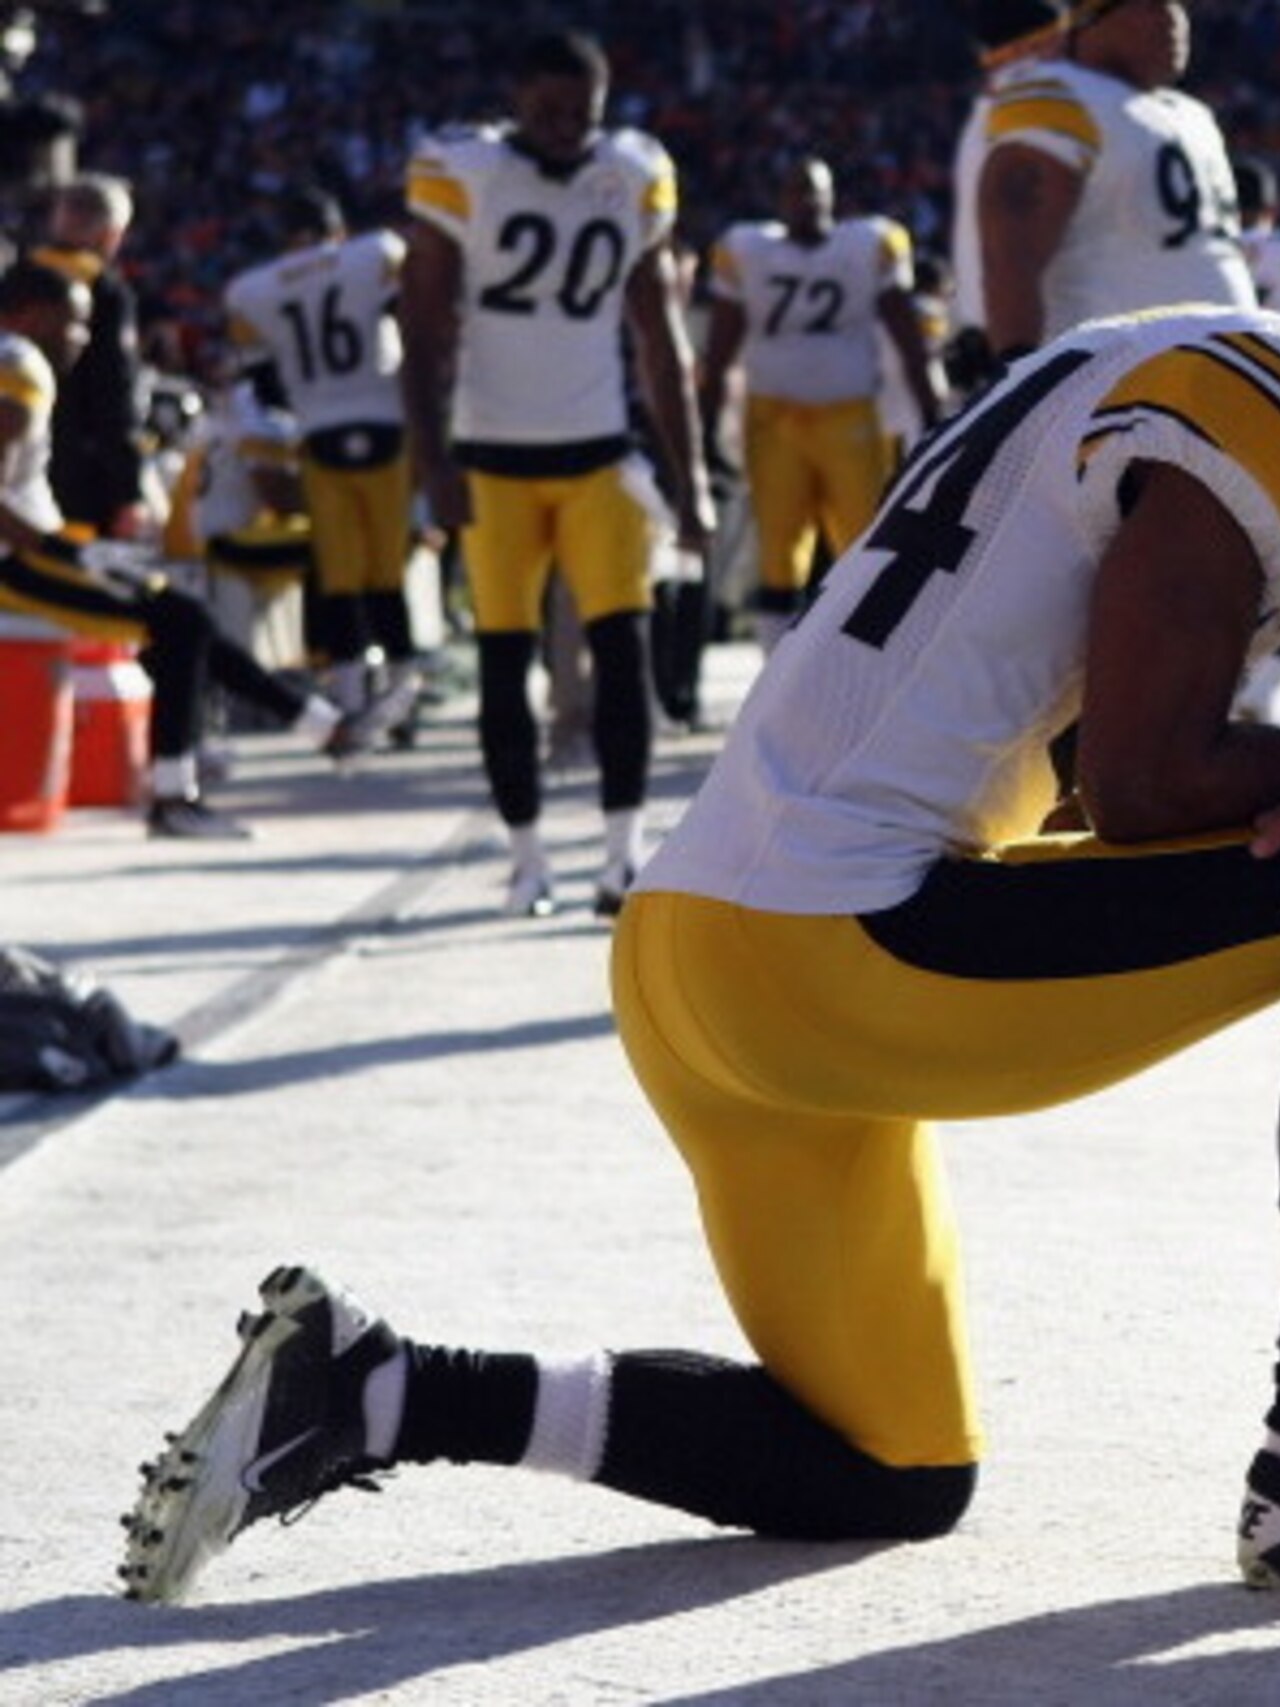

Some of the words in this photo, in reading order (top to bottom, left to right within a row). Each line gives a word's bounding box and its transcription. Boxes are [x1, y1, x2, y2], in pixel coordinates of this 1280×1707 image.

[1157, 142, 1238, 249] 9
[479, 211, 624, 320] 20
[765, 274, 845, 337] 72
[279, 282, 364, 384] 16
[838, 348, 1095, 650] 4
